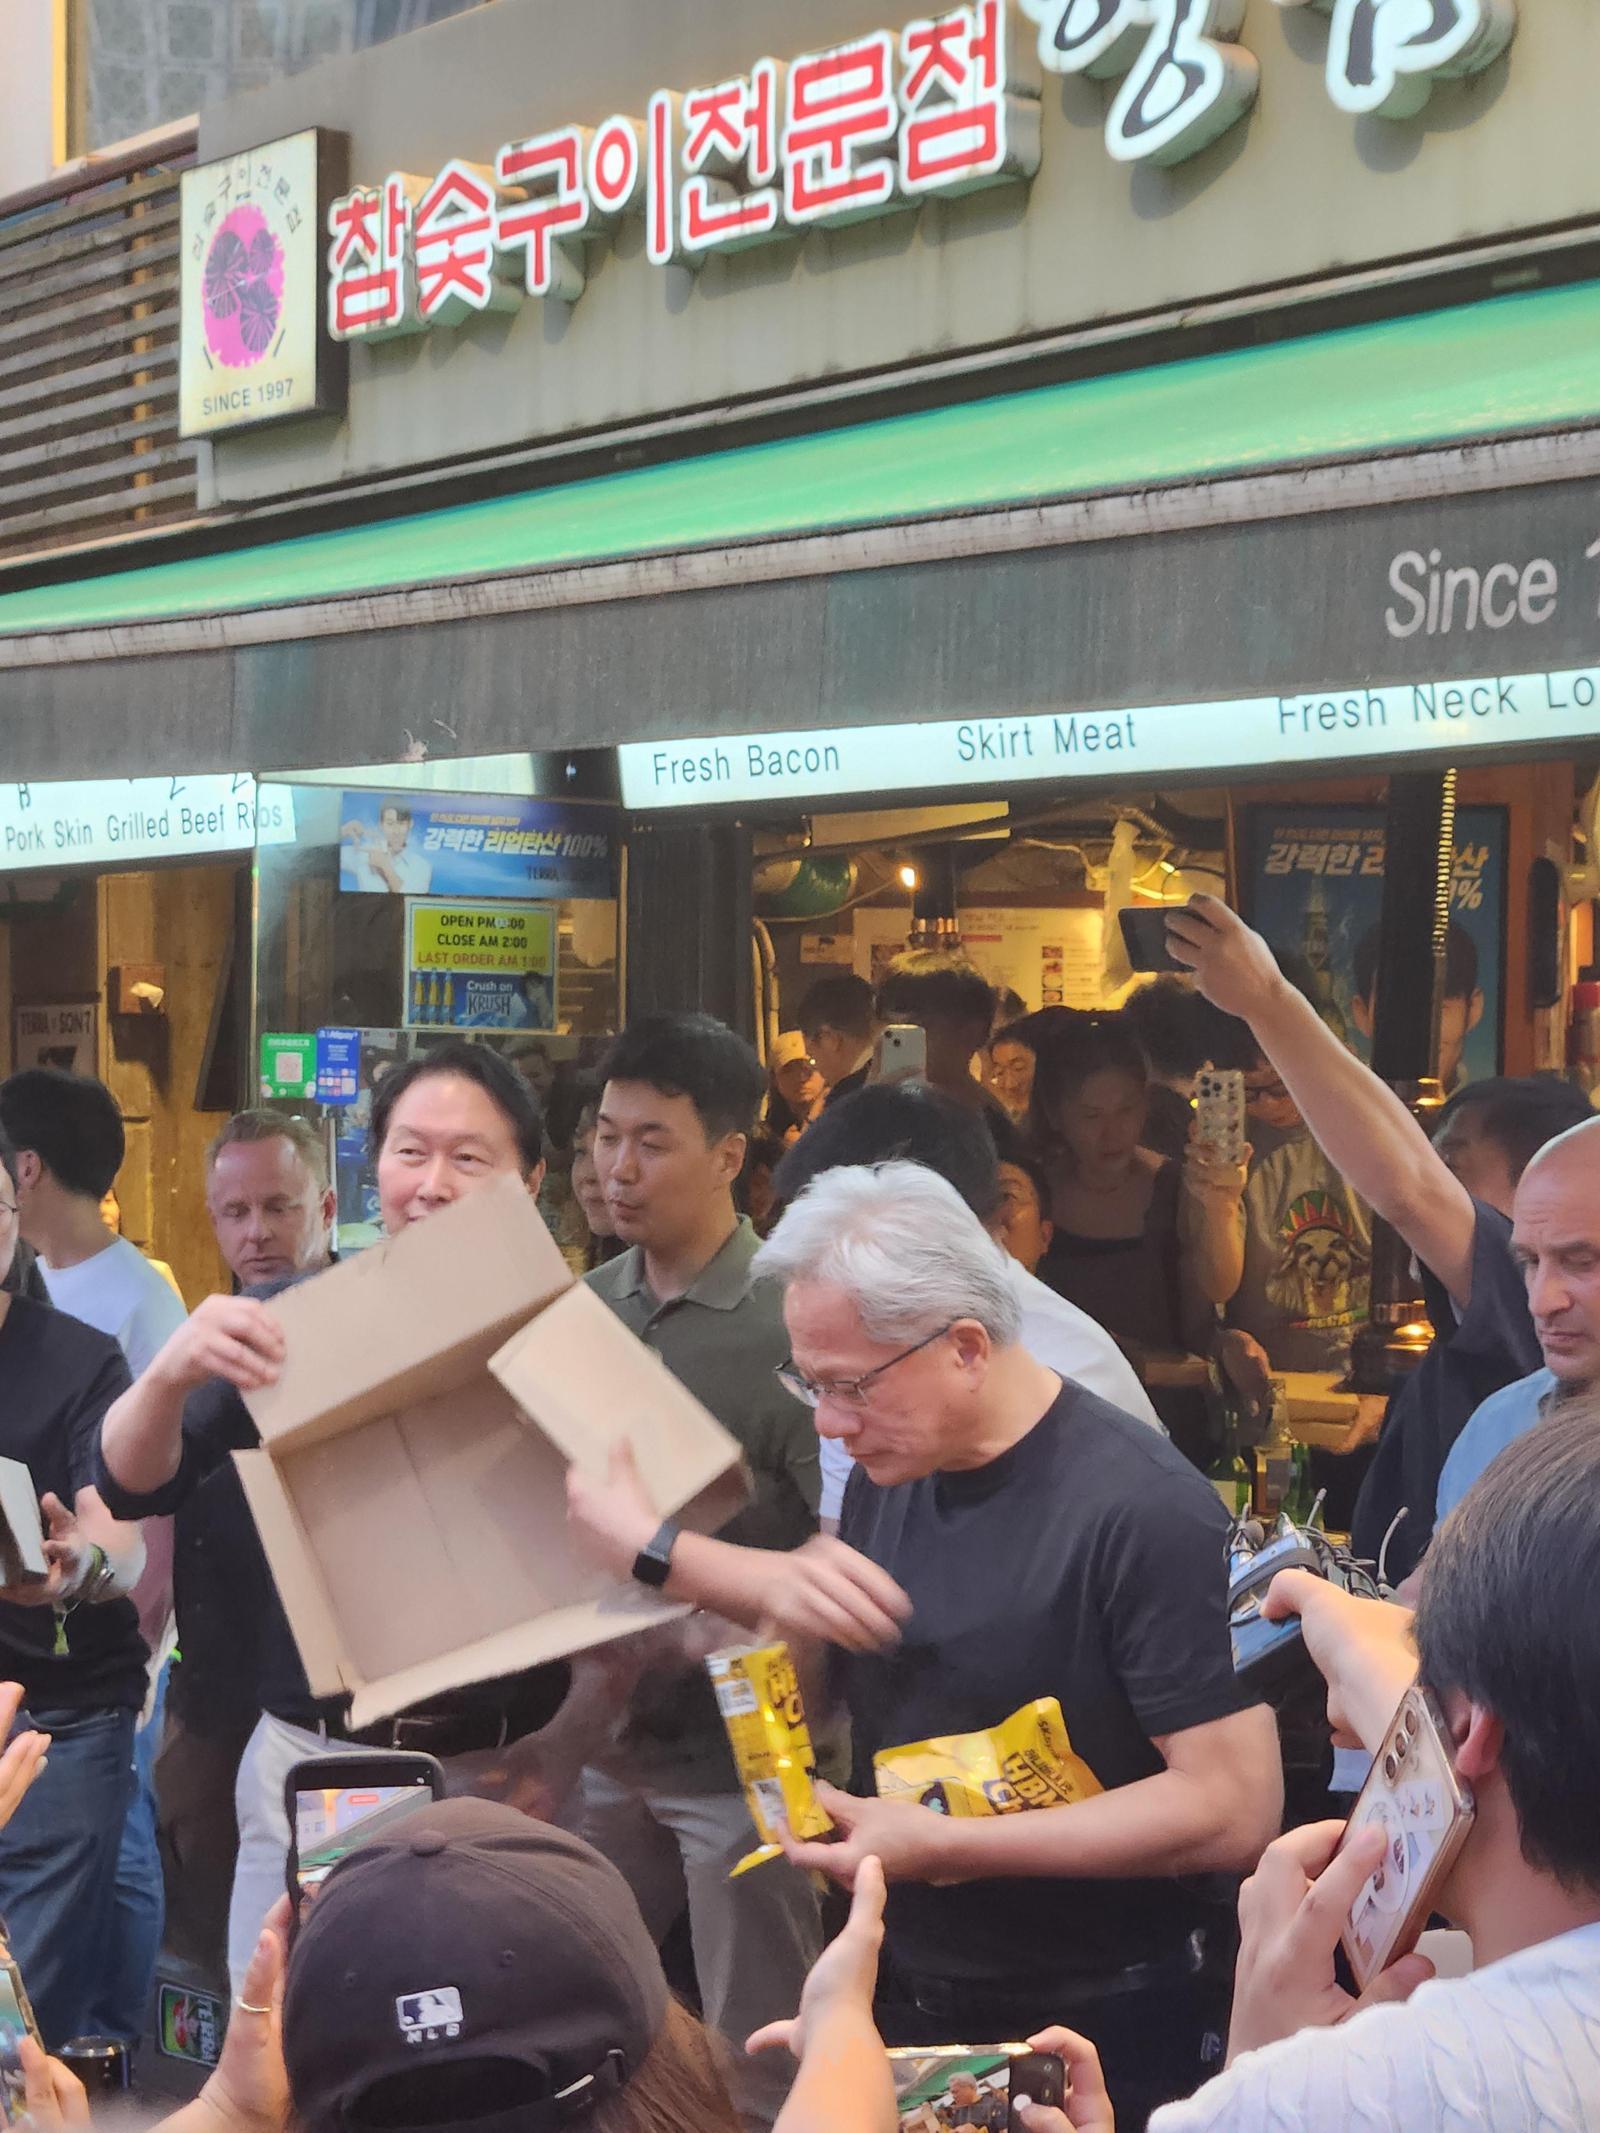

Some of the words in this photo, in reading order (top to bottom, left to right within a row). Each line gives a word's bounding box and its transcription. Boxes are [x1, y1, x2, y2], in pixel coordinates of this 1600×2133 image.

[329, 0, 1005, 338] 참숯구이전문점
[202, 388, 251, 416] SINCE
[257, 378, 294, 403] 1997
[1385, 548, 1558, 638] Since
[1278, 689, 1386, 734] Fresh
[1412, 677, 1518, 721] Neck
[957, 722, 1033, 761] Skirt
[1053, 713, 1136, 754] Meat
[653, 748, 731, 785] Fresh
[747, 744, 840, 777] Bacon
[4, 823, 46, 852] Pork
[54, 817, 93, 848] Skin
[106, 808, 170, 842] Grilled
[181, 803, 225, 834] Beef
[437, 933, 476, 946] CLOSE
[479, 935, 499, 947] AM
[440, 914, 474, 928] OPEN
[418, 951, 449, 964] LAST
[452, 953, 495, 966] ORDER
